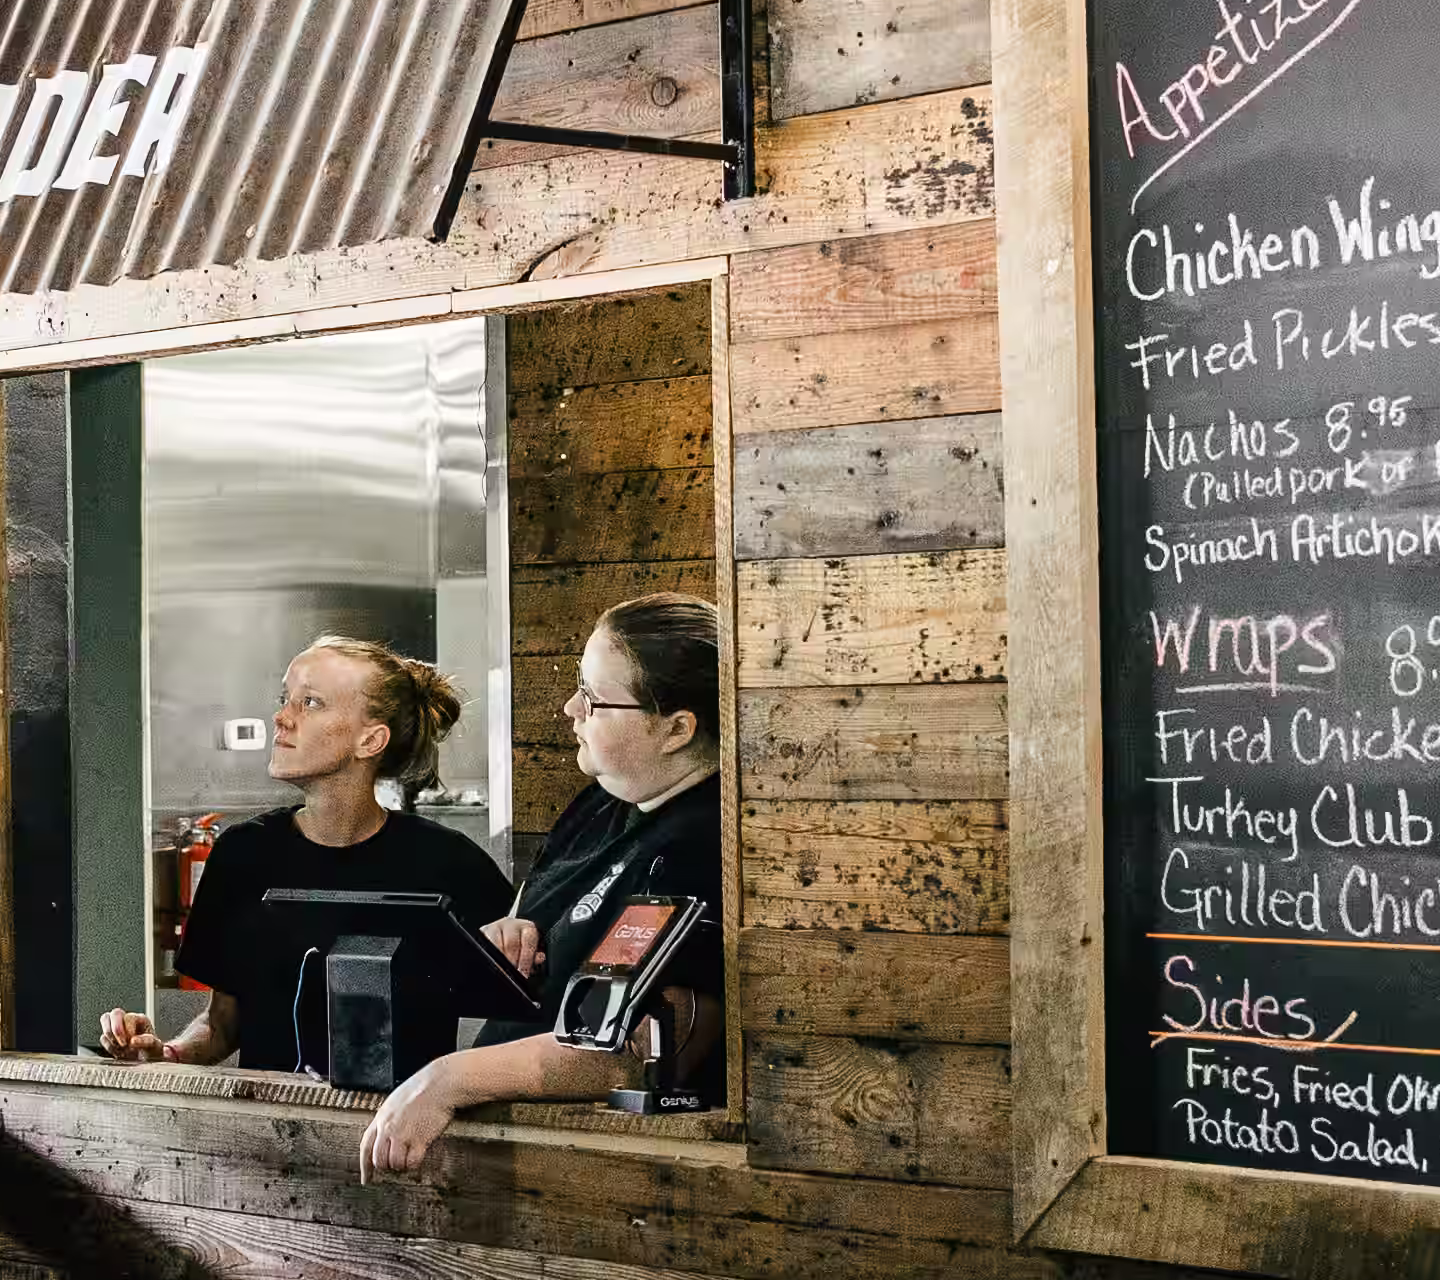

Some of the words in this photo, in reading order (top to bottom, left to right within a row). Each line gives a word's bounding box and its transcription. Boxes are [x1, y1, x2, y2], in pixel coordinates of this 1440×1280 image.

[1126, 213, 1320, 302] Chicken
[1125, 319, 1257, 390] Fried
[1143, 409, 1300, 478] Nachos
[1379, 456, 1413, 484] or
[1144, 524, 1278, 583] Spinach
[1148, 603, 1338, 697] Wraps
[1154, 707, 1273, 764] Fried
[1144, 776, 1300, 863] Turkey
[1310, 783, 1433, 847] Club
[1160, 847, 1328, 932] Grilled
[1162, 955, 1316, 1040] Sides
[1293, 1065, 1380, 1116] Fried
[1172, 1099, 1300, 1154] Potato
